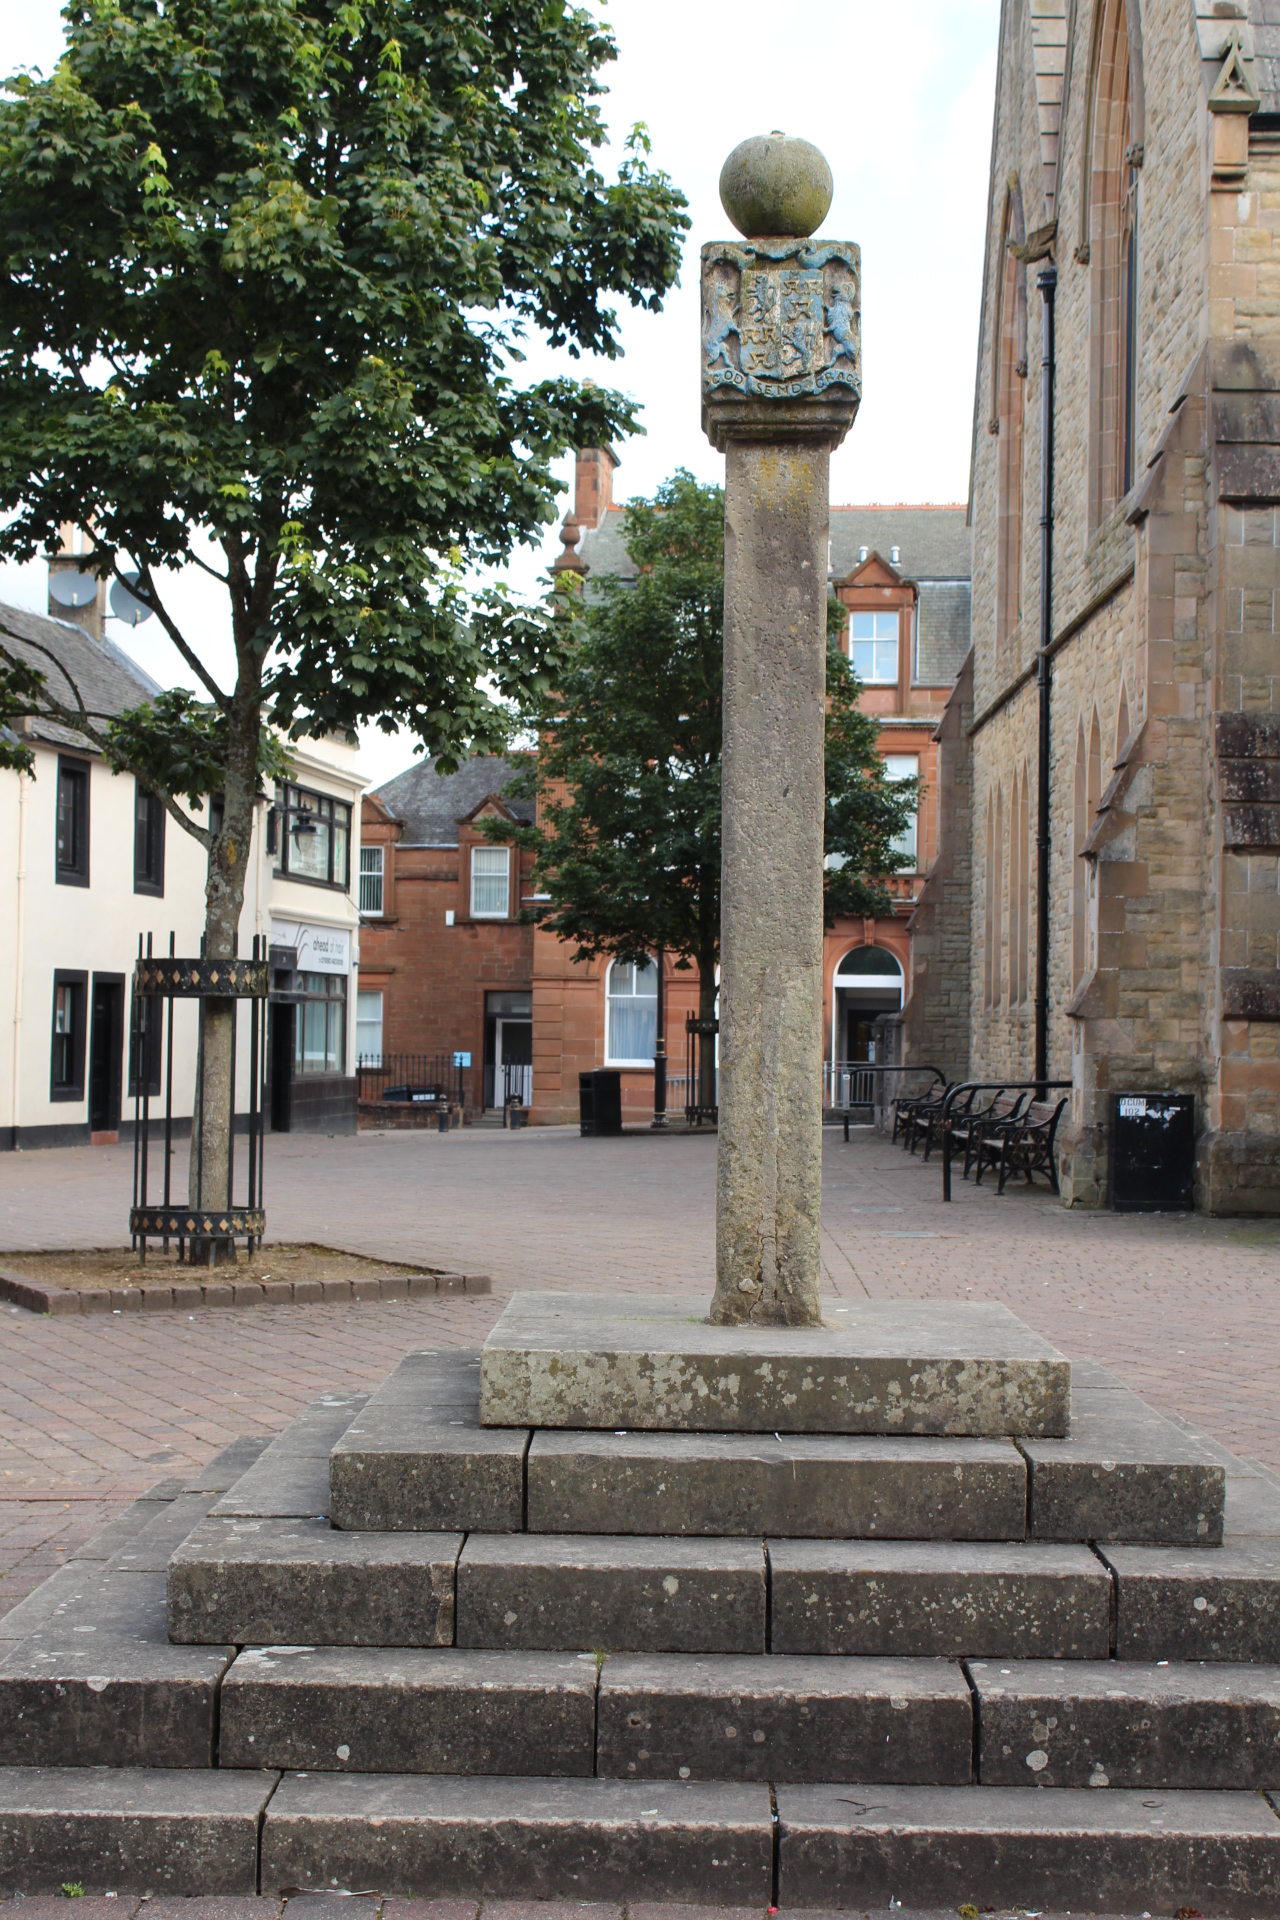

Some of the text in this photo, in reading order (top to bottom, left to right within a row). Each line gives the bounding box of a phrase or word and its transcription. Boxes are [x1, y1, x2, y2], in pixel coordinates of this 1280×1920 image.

[755, 382, 802, 396] SEND
[313, 934, 329, 952] ahead
[1125, 1108, 1140, 1116] 102
